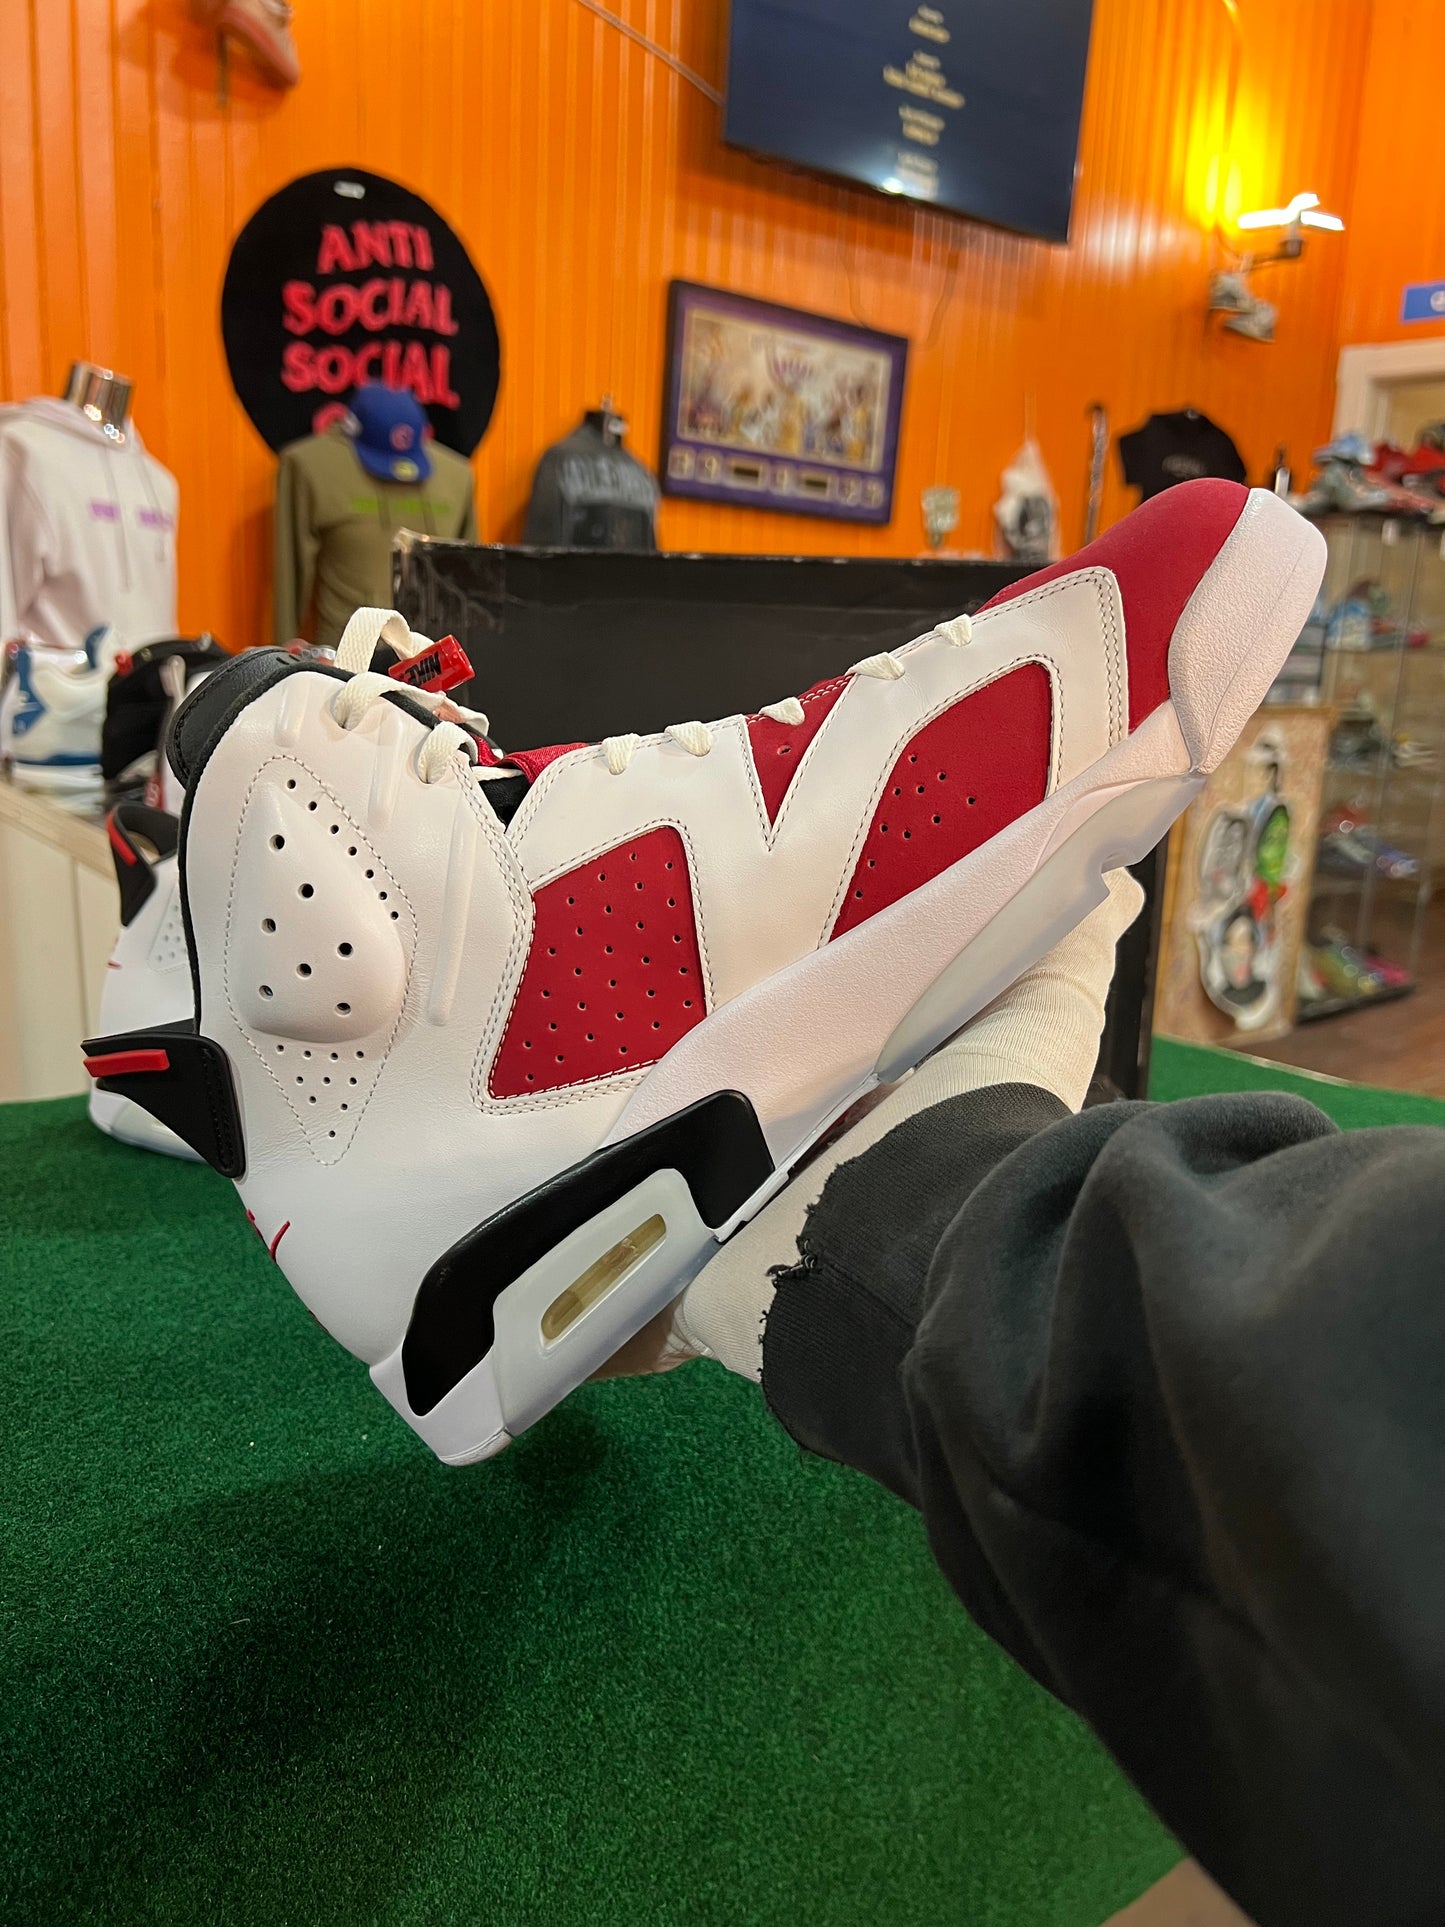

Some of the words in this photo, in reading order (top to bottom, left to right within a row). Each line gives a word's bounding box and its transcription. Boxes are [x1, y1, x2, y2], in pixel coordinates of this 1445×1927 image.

[316, 219, 434, 275] ANTI
[282, 277, 459, 336] SOCIAL
[281, 339, 461, 410] SOCIAL
